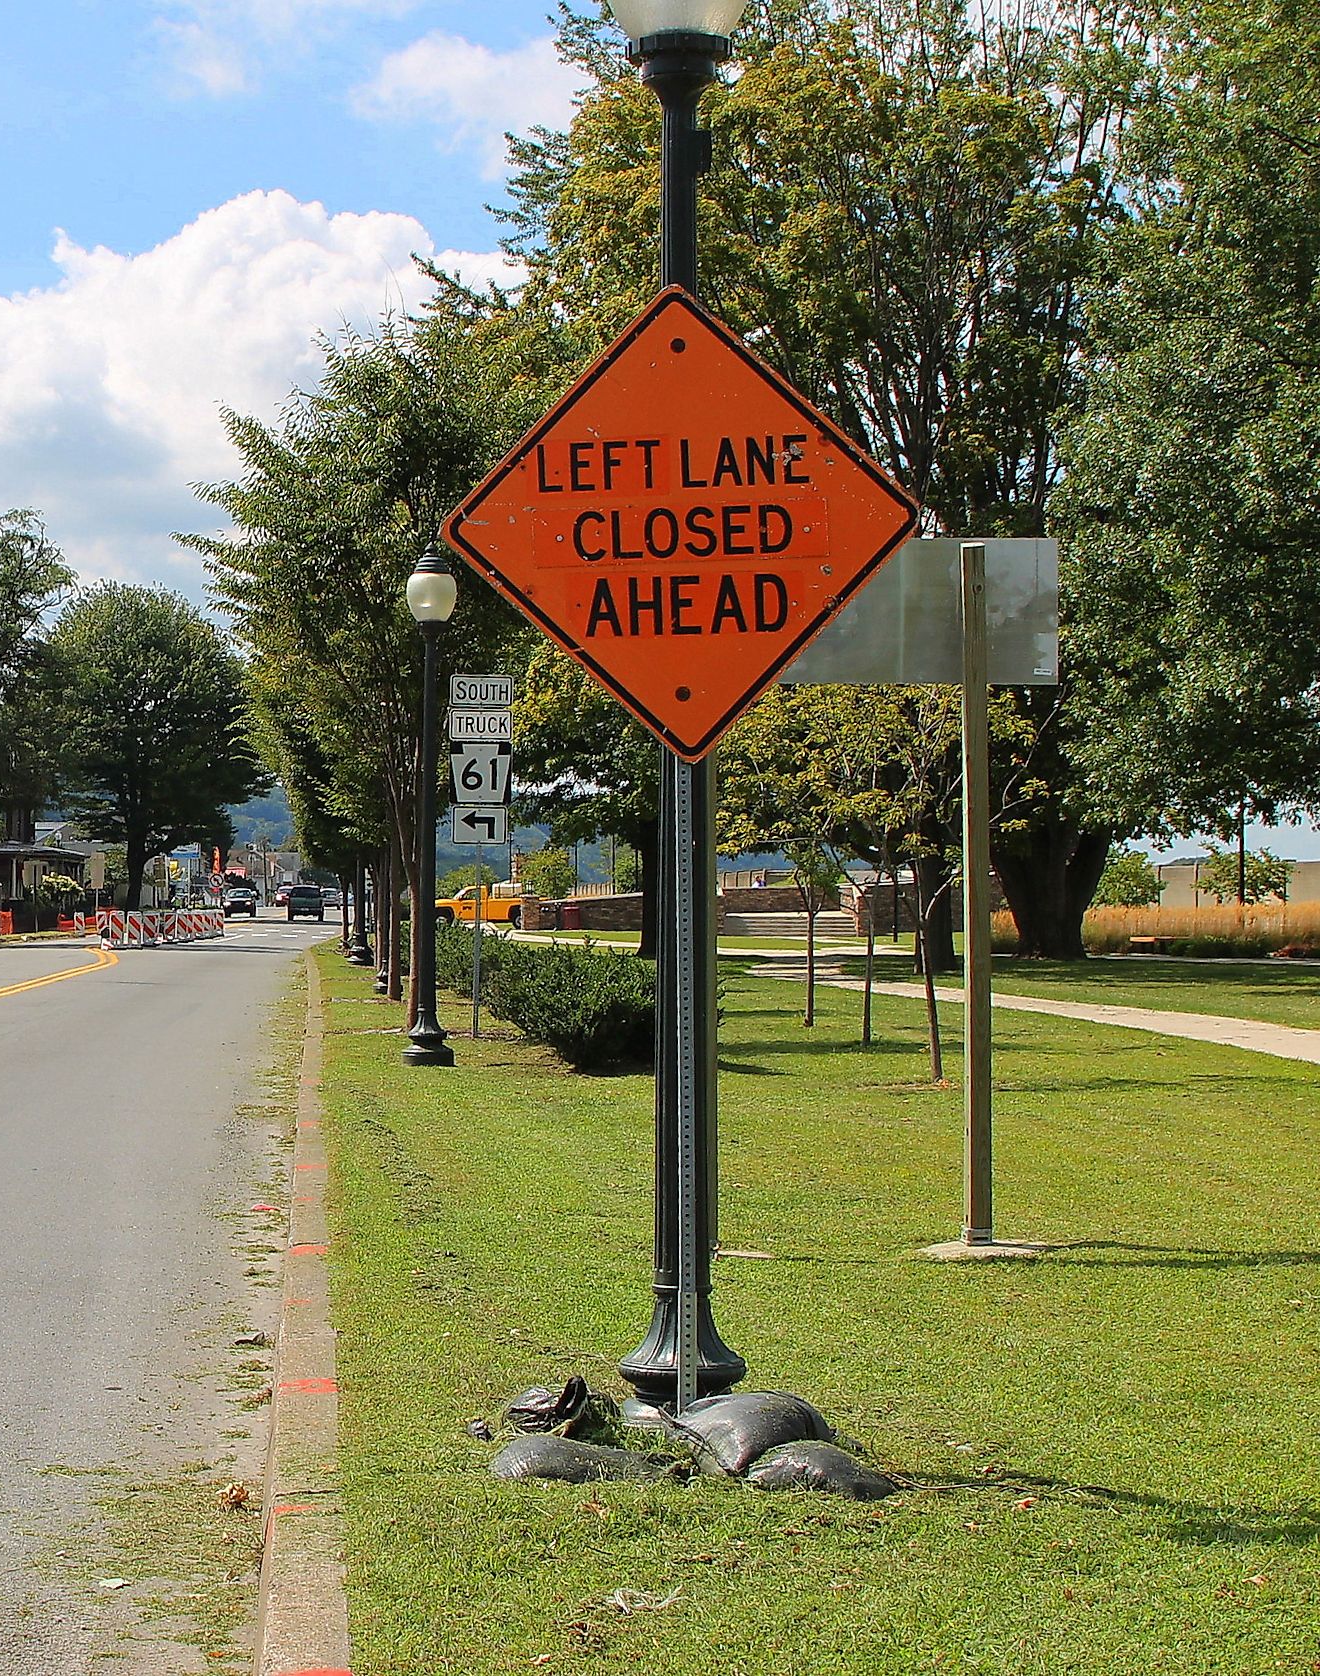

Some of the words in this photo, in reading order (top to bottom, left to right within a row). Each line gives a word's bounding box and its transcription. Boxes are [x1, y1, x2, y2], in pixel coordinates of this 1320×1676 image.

[536, 440, 661, 493] LEFT
[680, 433, 810, 488] LANE
[572, 504, 794, 562] CLOSED
[585, 573, 789, 637] AHEAD
[455, 680, 509, 701] SOUTH
[455, 716, 509, 734] TRUCK
[461, 757, 498, 791] 61
